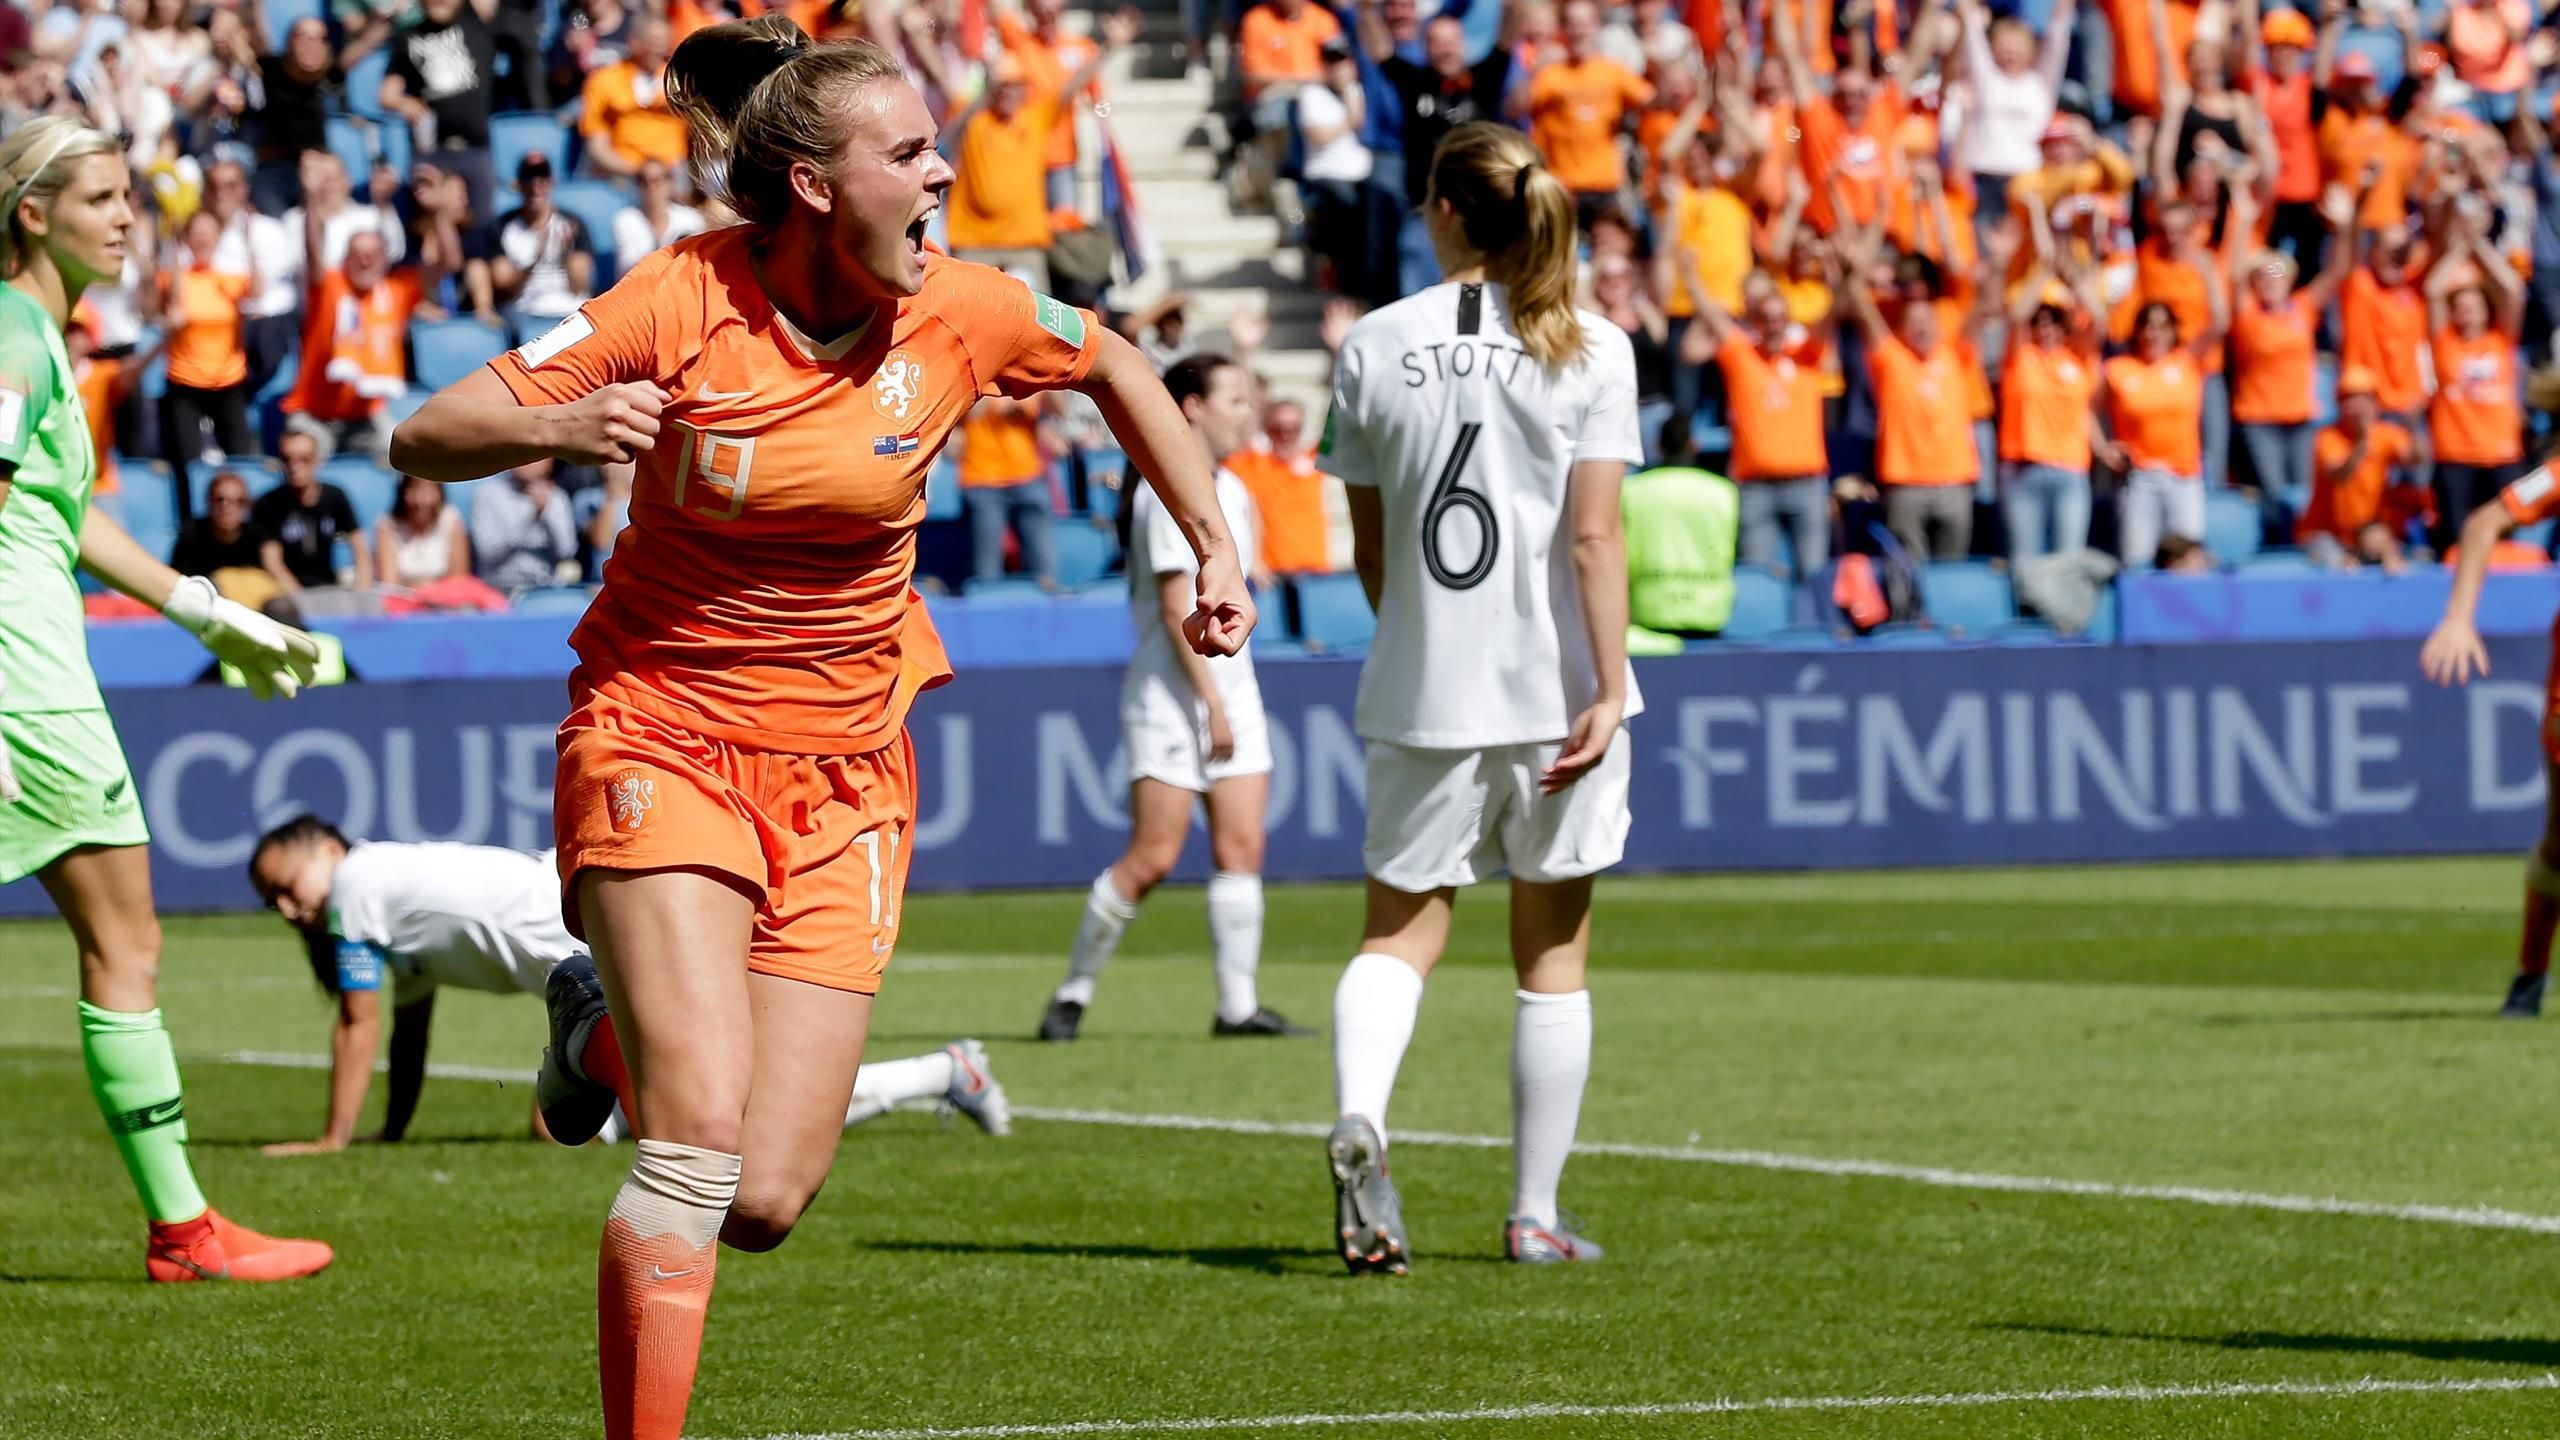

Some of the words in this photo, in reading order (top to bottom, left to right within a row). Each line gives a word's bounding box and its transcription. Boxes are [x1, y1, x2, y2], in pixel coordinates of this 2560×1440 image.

[1402, 342, 1527, 388] STOTT
[669, 420, 756, 521] 19
[1422, 422, 1499, 590] 6
[1662, 664, 2417, 830] FÉMININE
